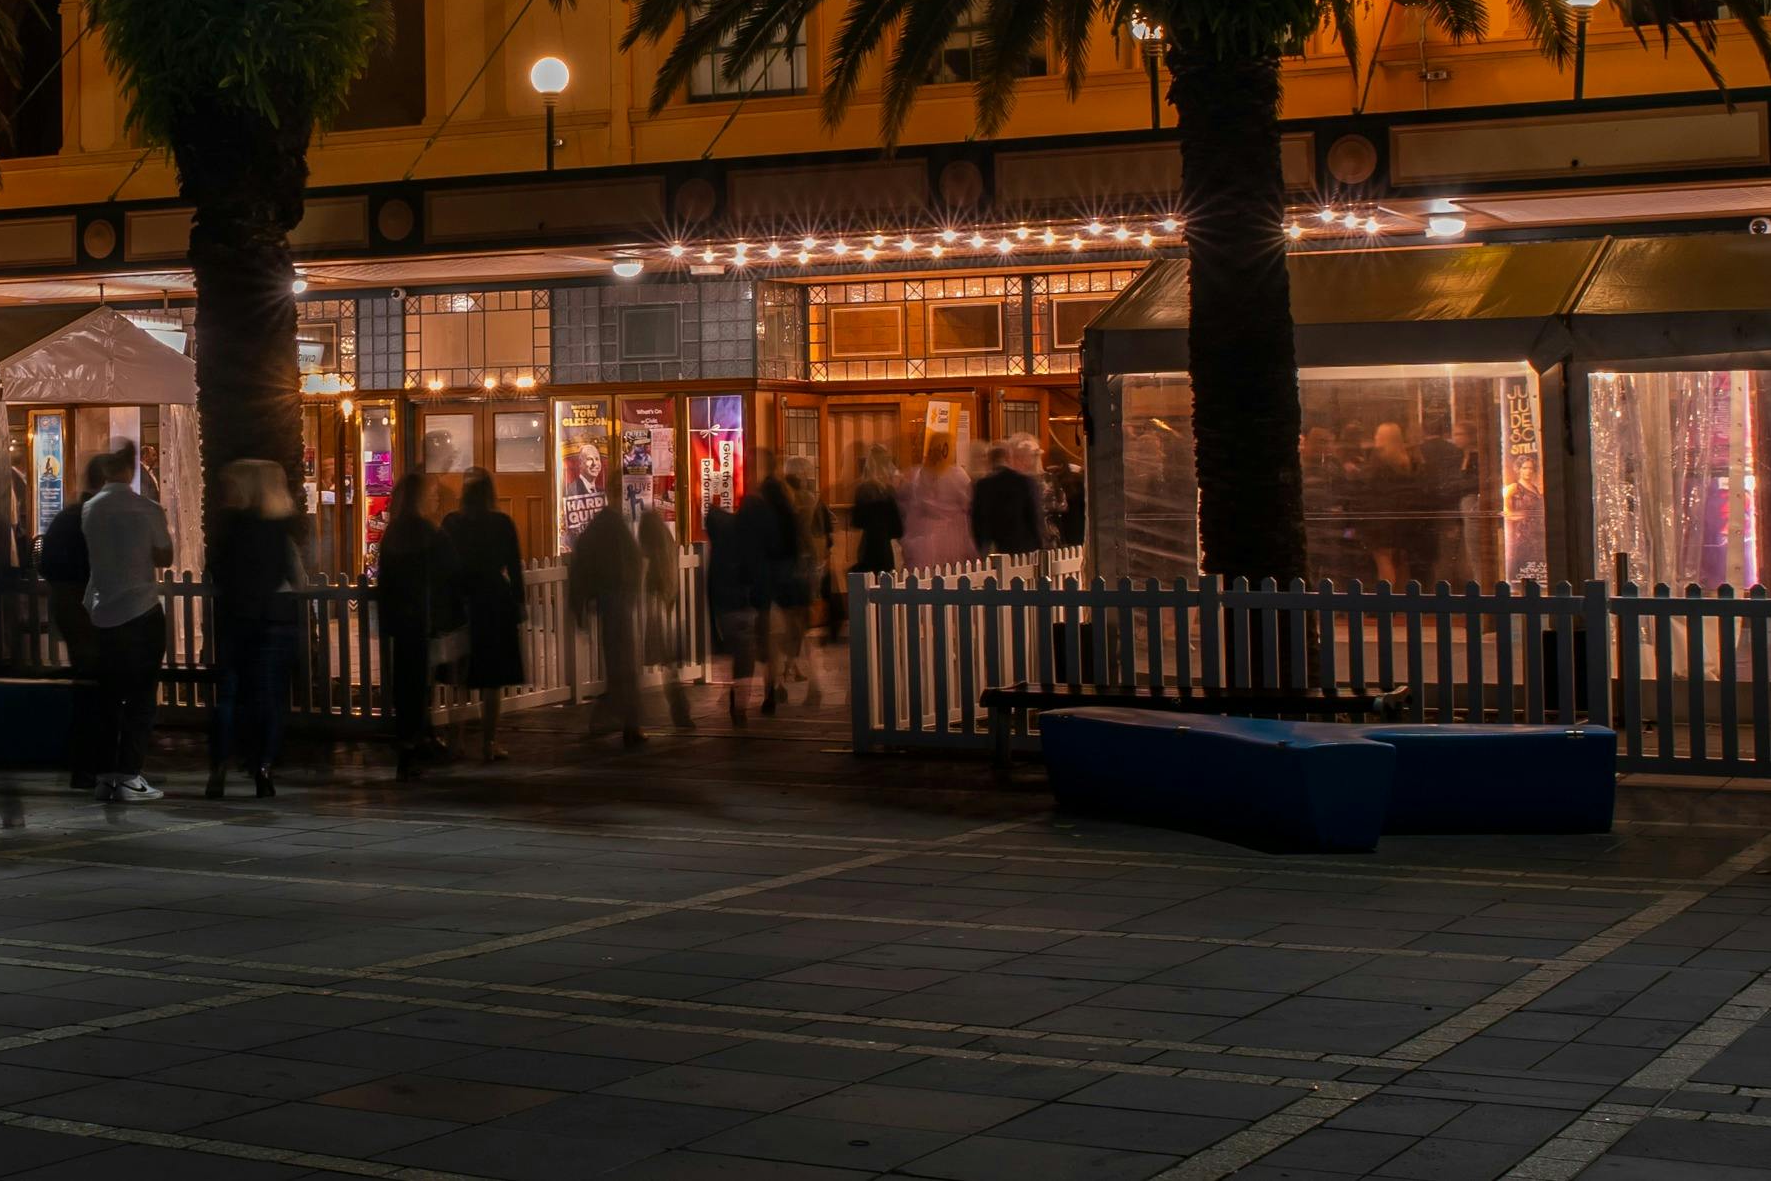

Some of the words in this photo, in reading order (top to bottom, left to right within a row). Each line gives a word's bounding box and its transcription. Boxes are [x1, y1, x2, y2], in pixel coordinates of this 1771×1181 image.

[1507, 385, 1528, 400] JU
[573, 409, 597, 418] TOM
[1510, 399, 1529, 414] LU
[562, 417, 608, 427] GLEESON
[1511, 413, 1532, 429] DE
[723, 443, 732, 468] Give
[703, 460, 712, 515] performan
[722, 471, 732, 488] the
[566, 496, 604, 512] HARD
[568, 508, 603, 524] QUI
